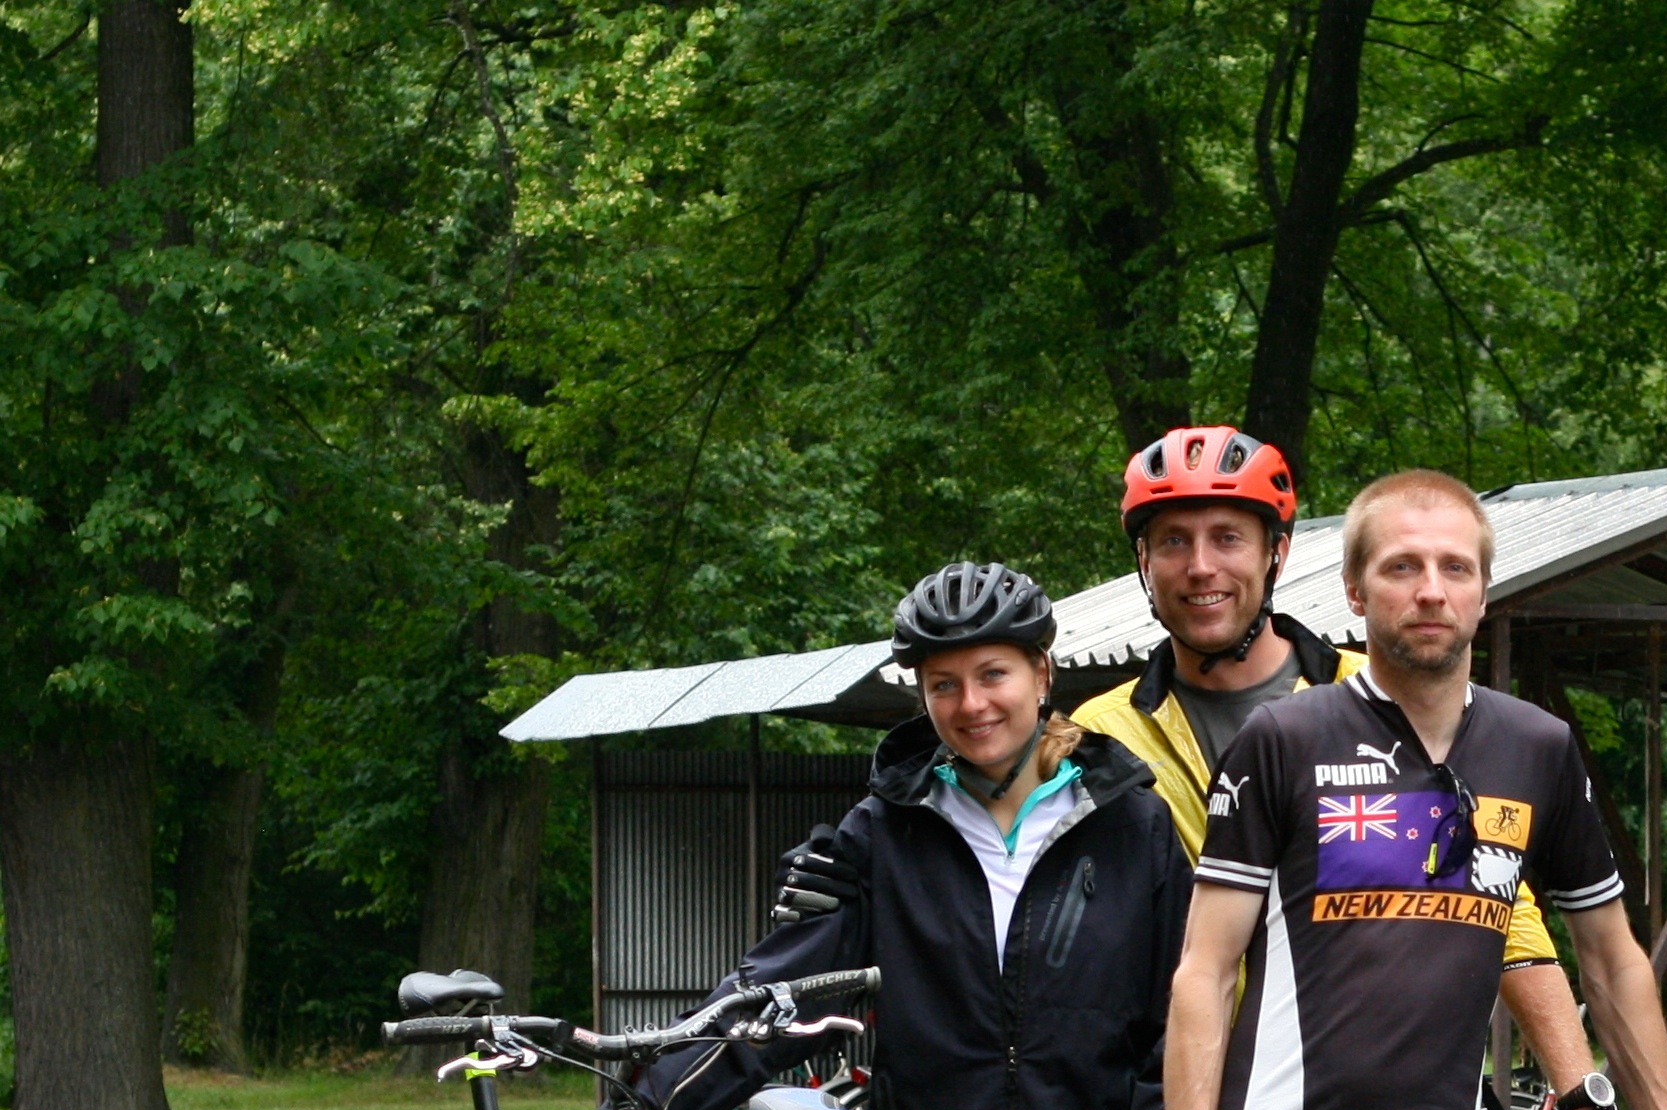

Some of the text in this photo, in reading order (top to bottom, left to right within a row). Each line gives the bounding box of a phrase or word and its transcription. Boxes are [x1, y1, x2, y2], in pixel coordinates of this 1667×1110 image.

[1315, 762, 1388, 787] PUMA
[1322, 893, 1508, 931] NEW ZEALAND
[801, 969, 860, 992] RITCHEY
